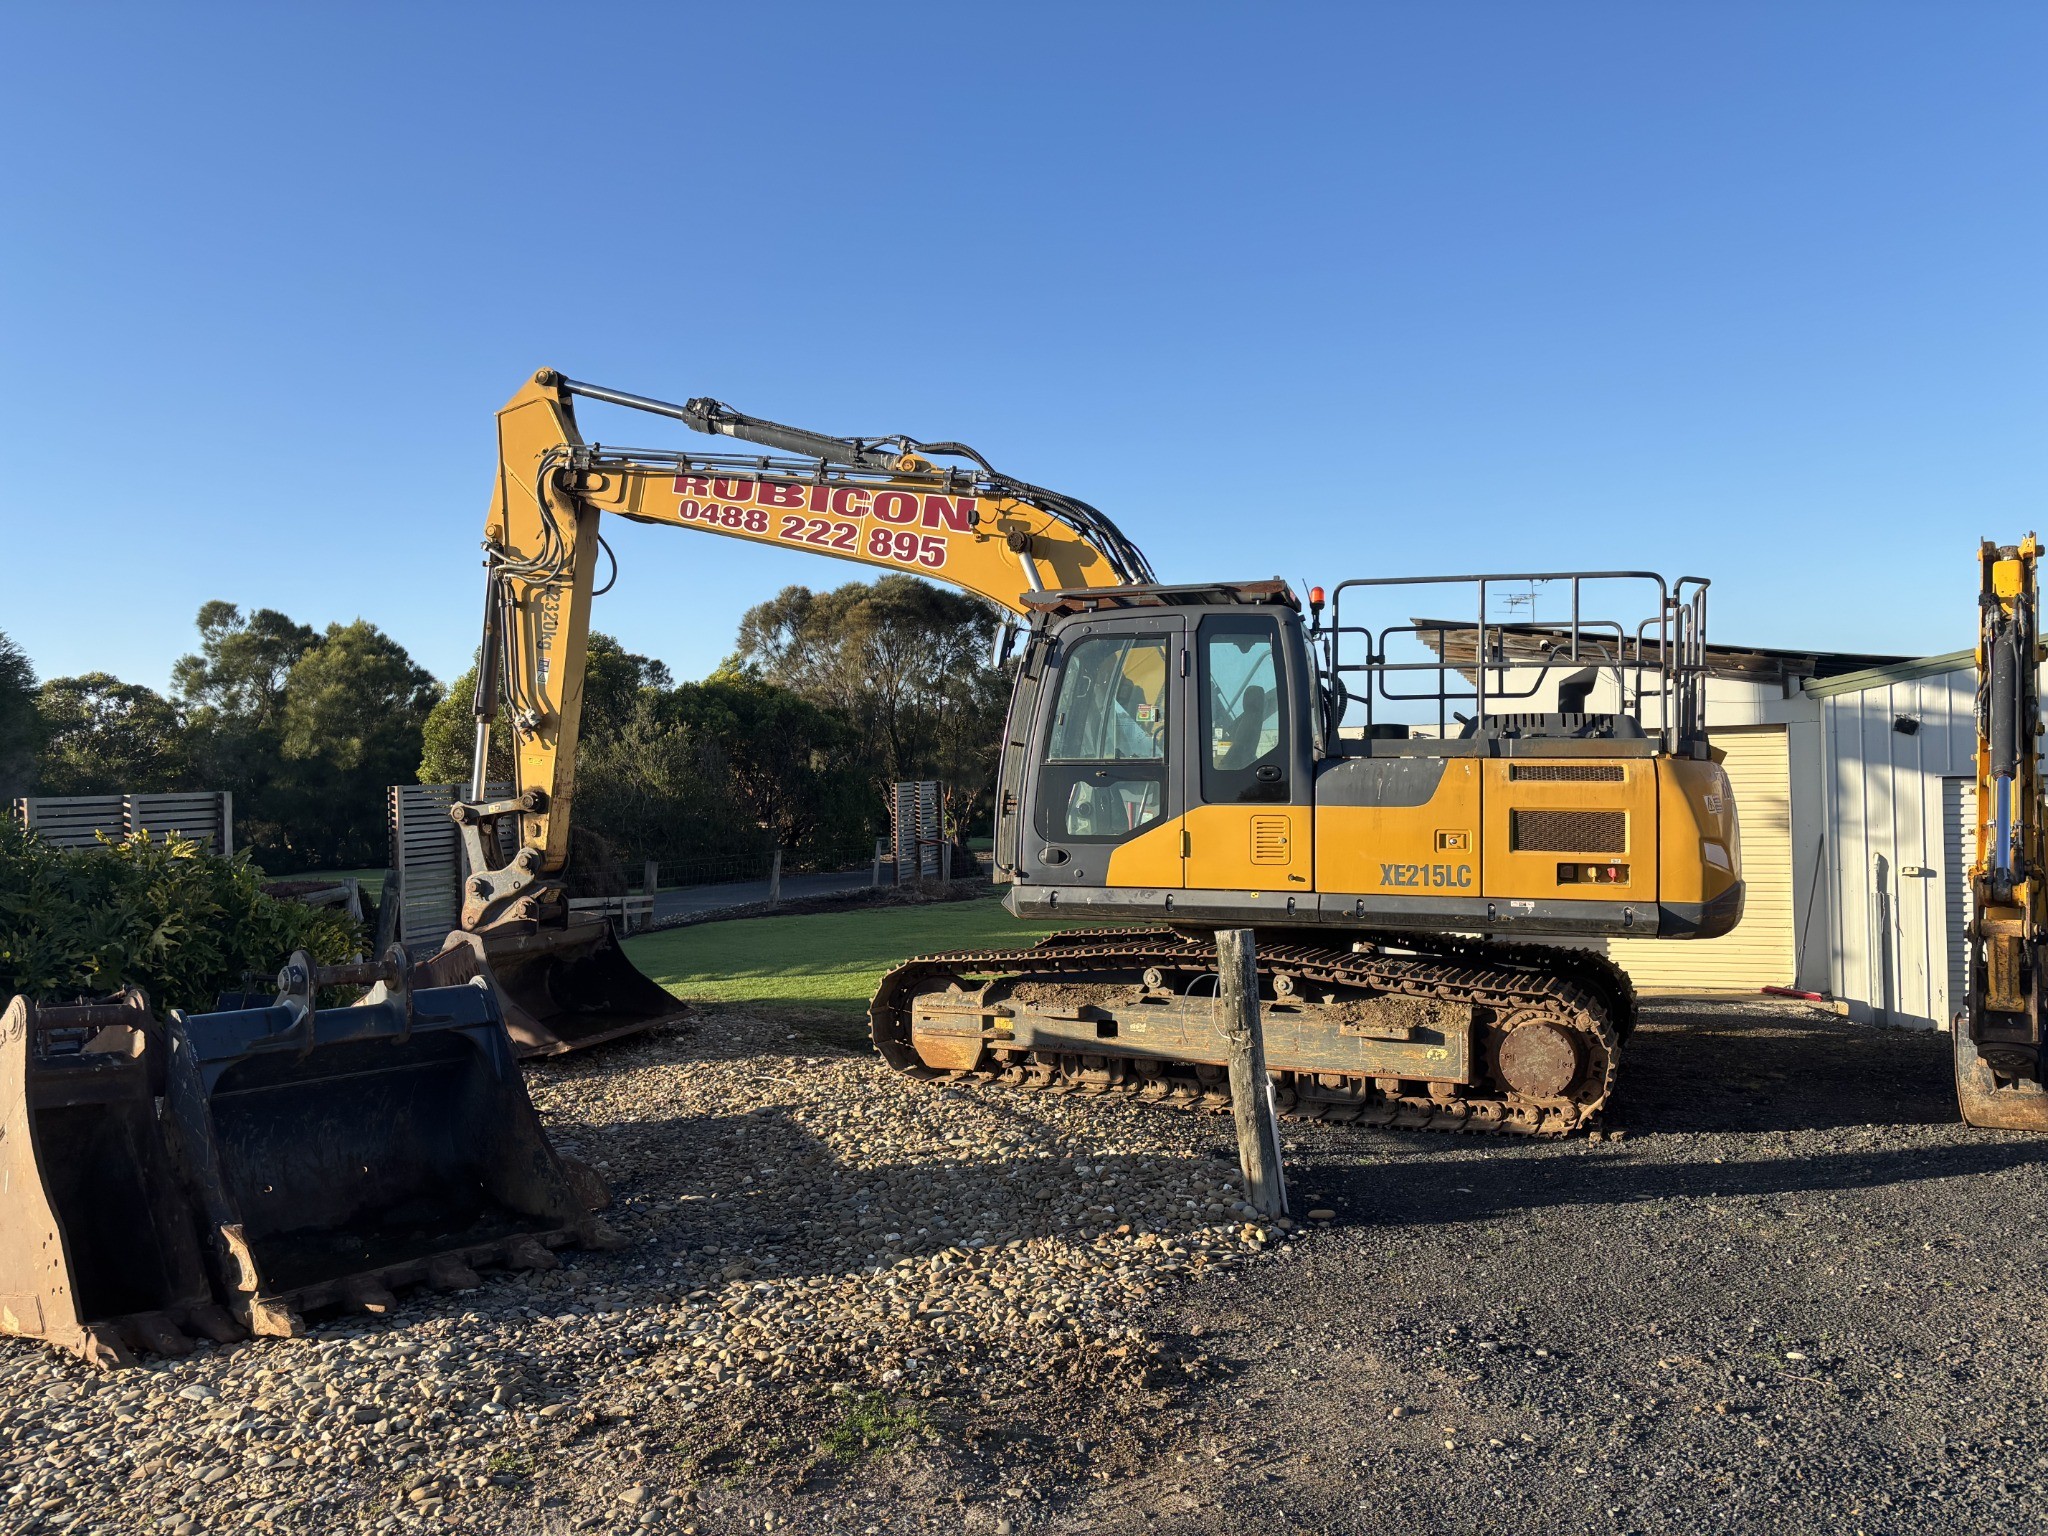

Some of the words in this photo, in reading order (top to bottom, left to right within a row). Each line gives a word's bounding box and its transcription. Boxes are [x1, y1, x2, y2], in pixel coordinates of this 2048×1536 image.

[672, 474, 978, 534] RUBICON
[678, 498, 770, 534] 0488
[778, 515, 859, 553] 222
[867, 526, 948, 569] 895
[1380, 863, 1472, 887] XE215LC
